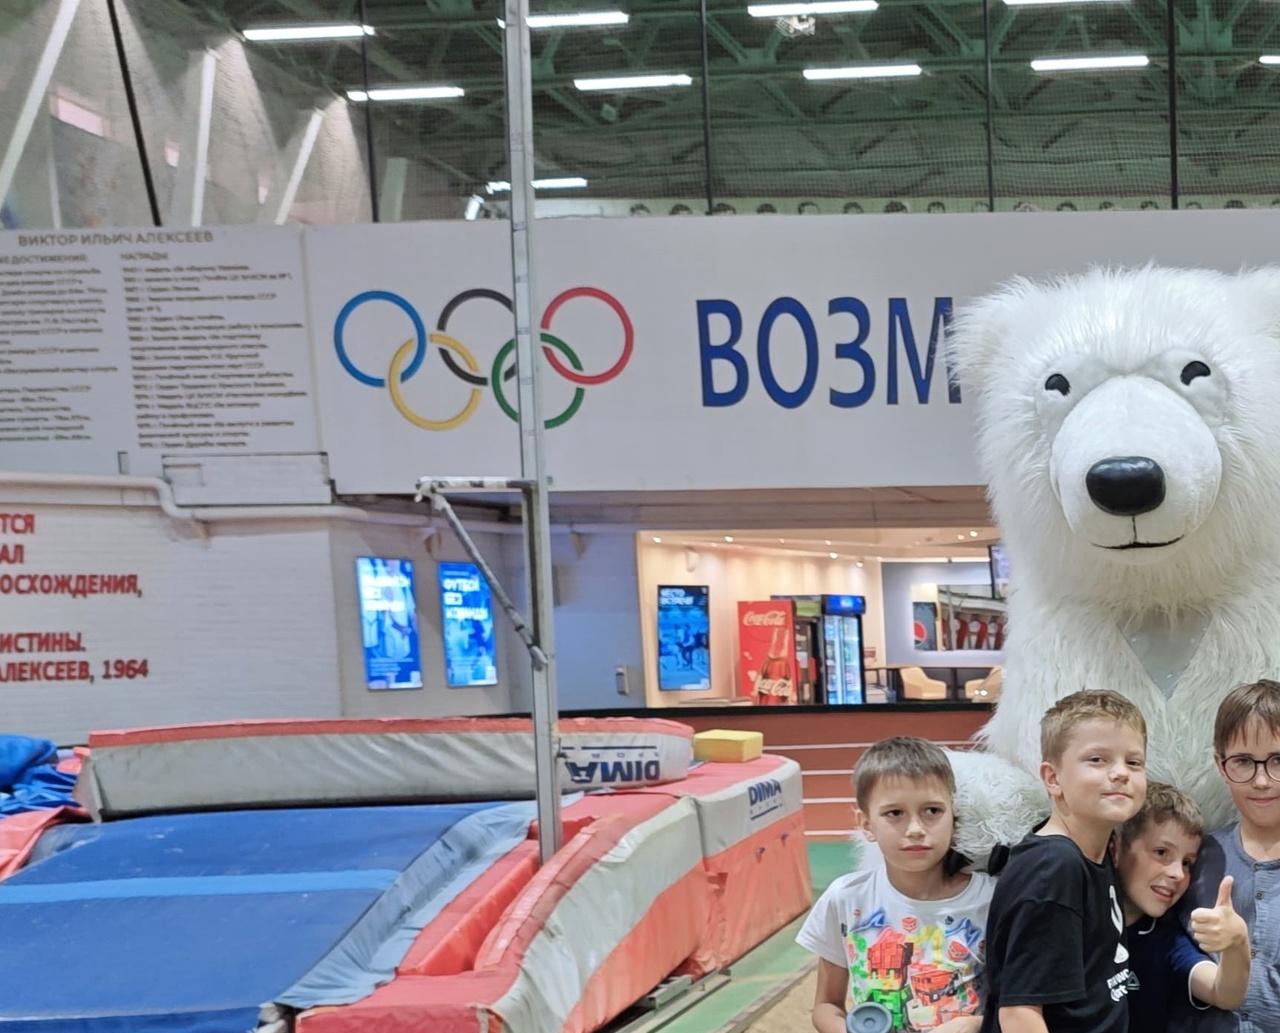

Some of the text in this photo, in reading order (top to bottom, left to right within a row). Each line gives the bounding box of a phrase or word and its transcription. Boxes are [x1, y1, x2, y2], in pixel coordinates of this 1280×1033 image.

[18, 231, 214, 247] ВИКТОР ИЛЬИЧ АЛЕКСЕЕВ
[102, 659, 148, 680] 1964
[564, 760, 660, 784] DIMA
[748, 779, 782, 807] DIMA
